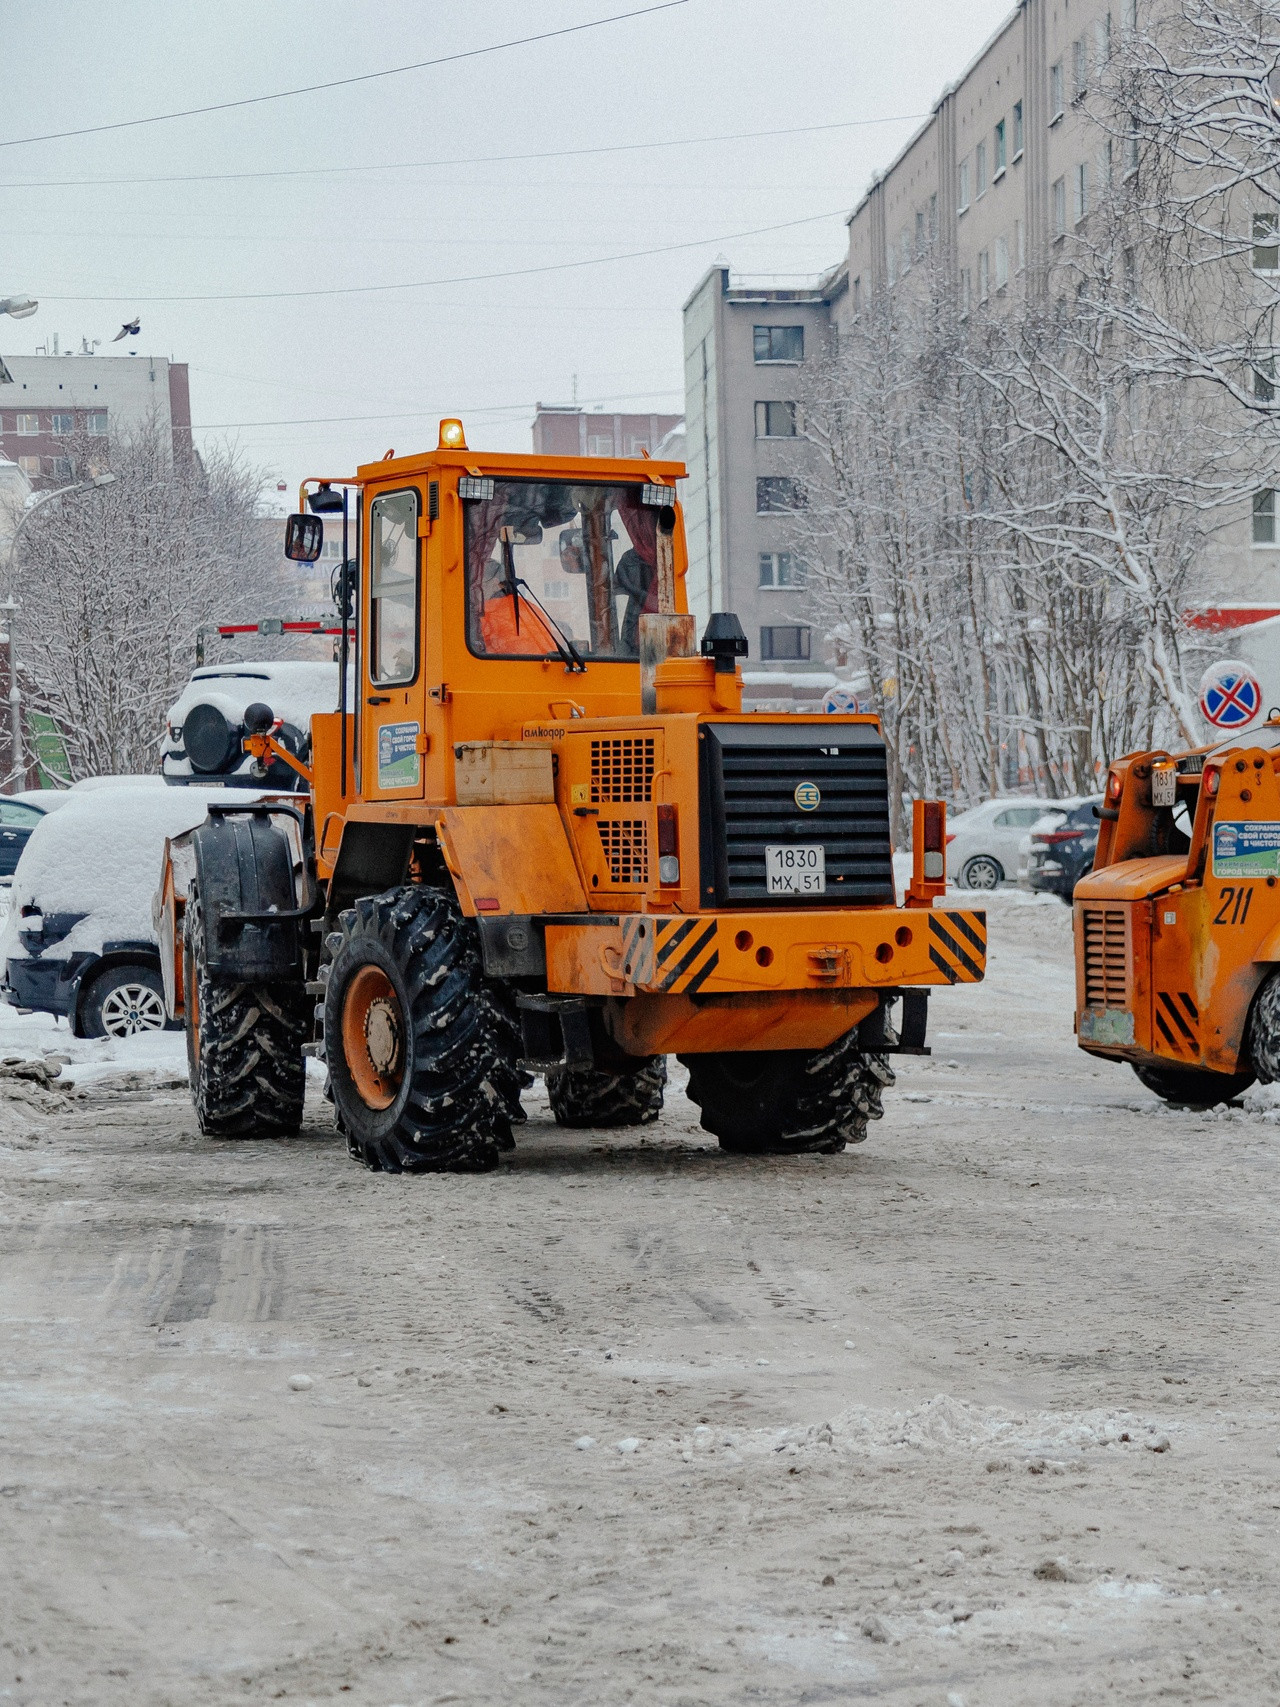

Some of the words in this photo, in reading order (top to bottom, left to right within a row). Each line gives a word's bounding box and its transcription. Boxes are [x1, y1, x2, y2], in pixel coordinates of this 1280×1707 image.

[1155, 771, 1173, 787] 1831
[1166, 791, 1174, 803] 51
[1238, 832, 1258, 840] СВОЙ
[775, 849, 817, 868] 1830
[803, 875, 821, 890] 51
[1212, 887, 1254, 925] 211
